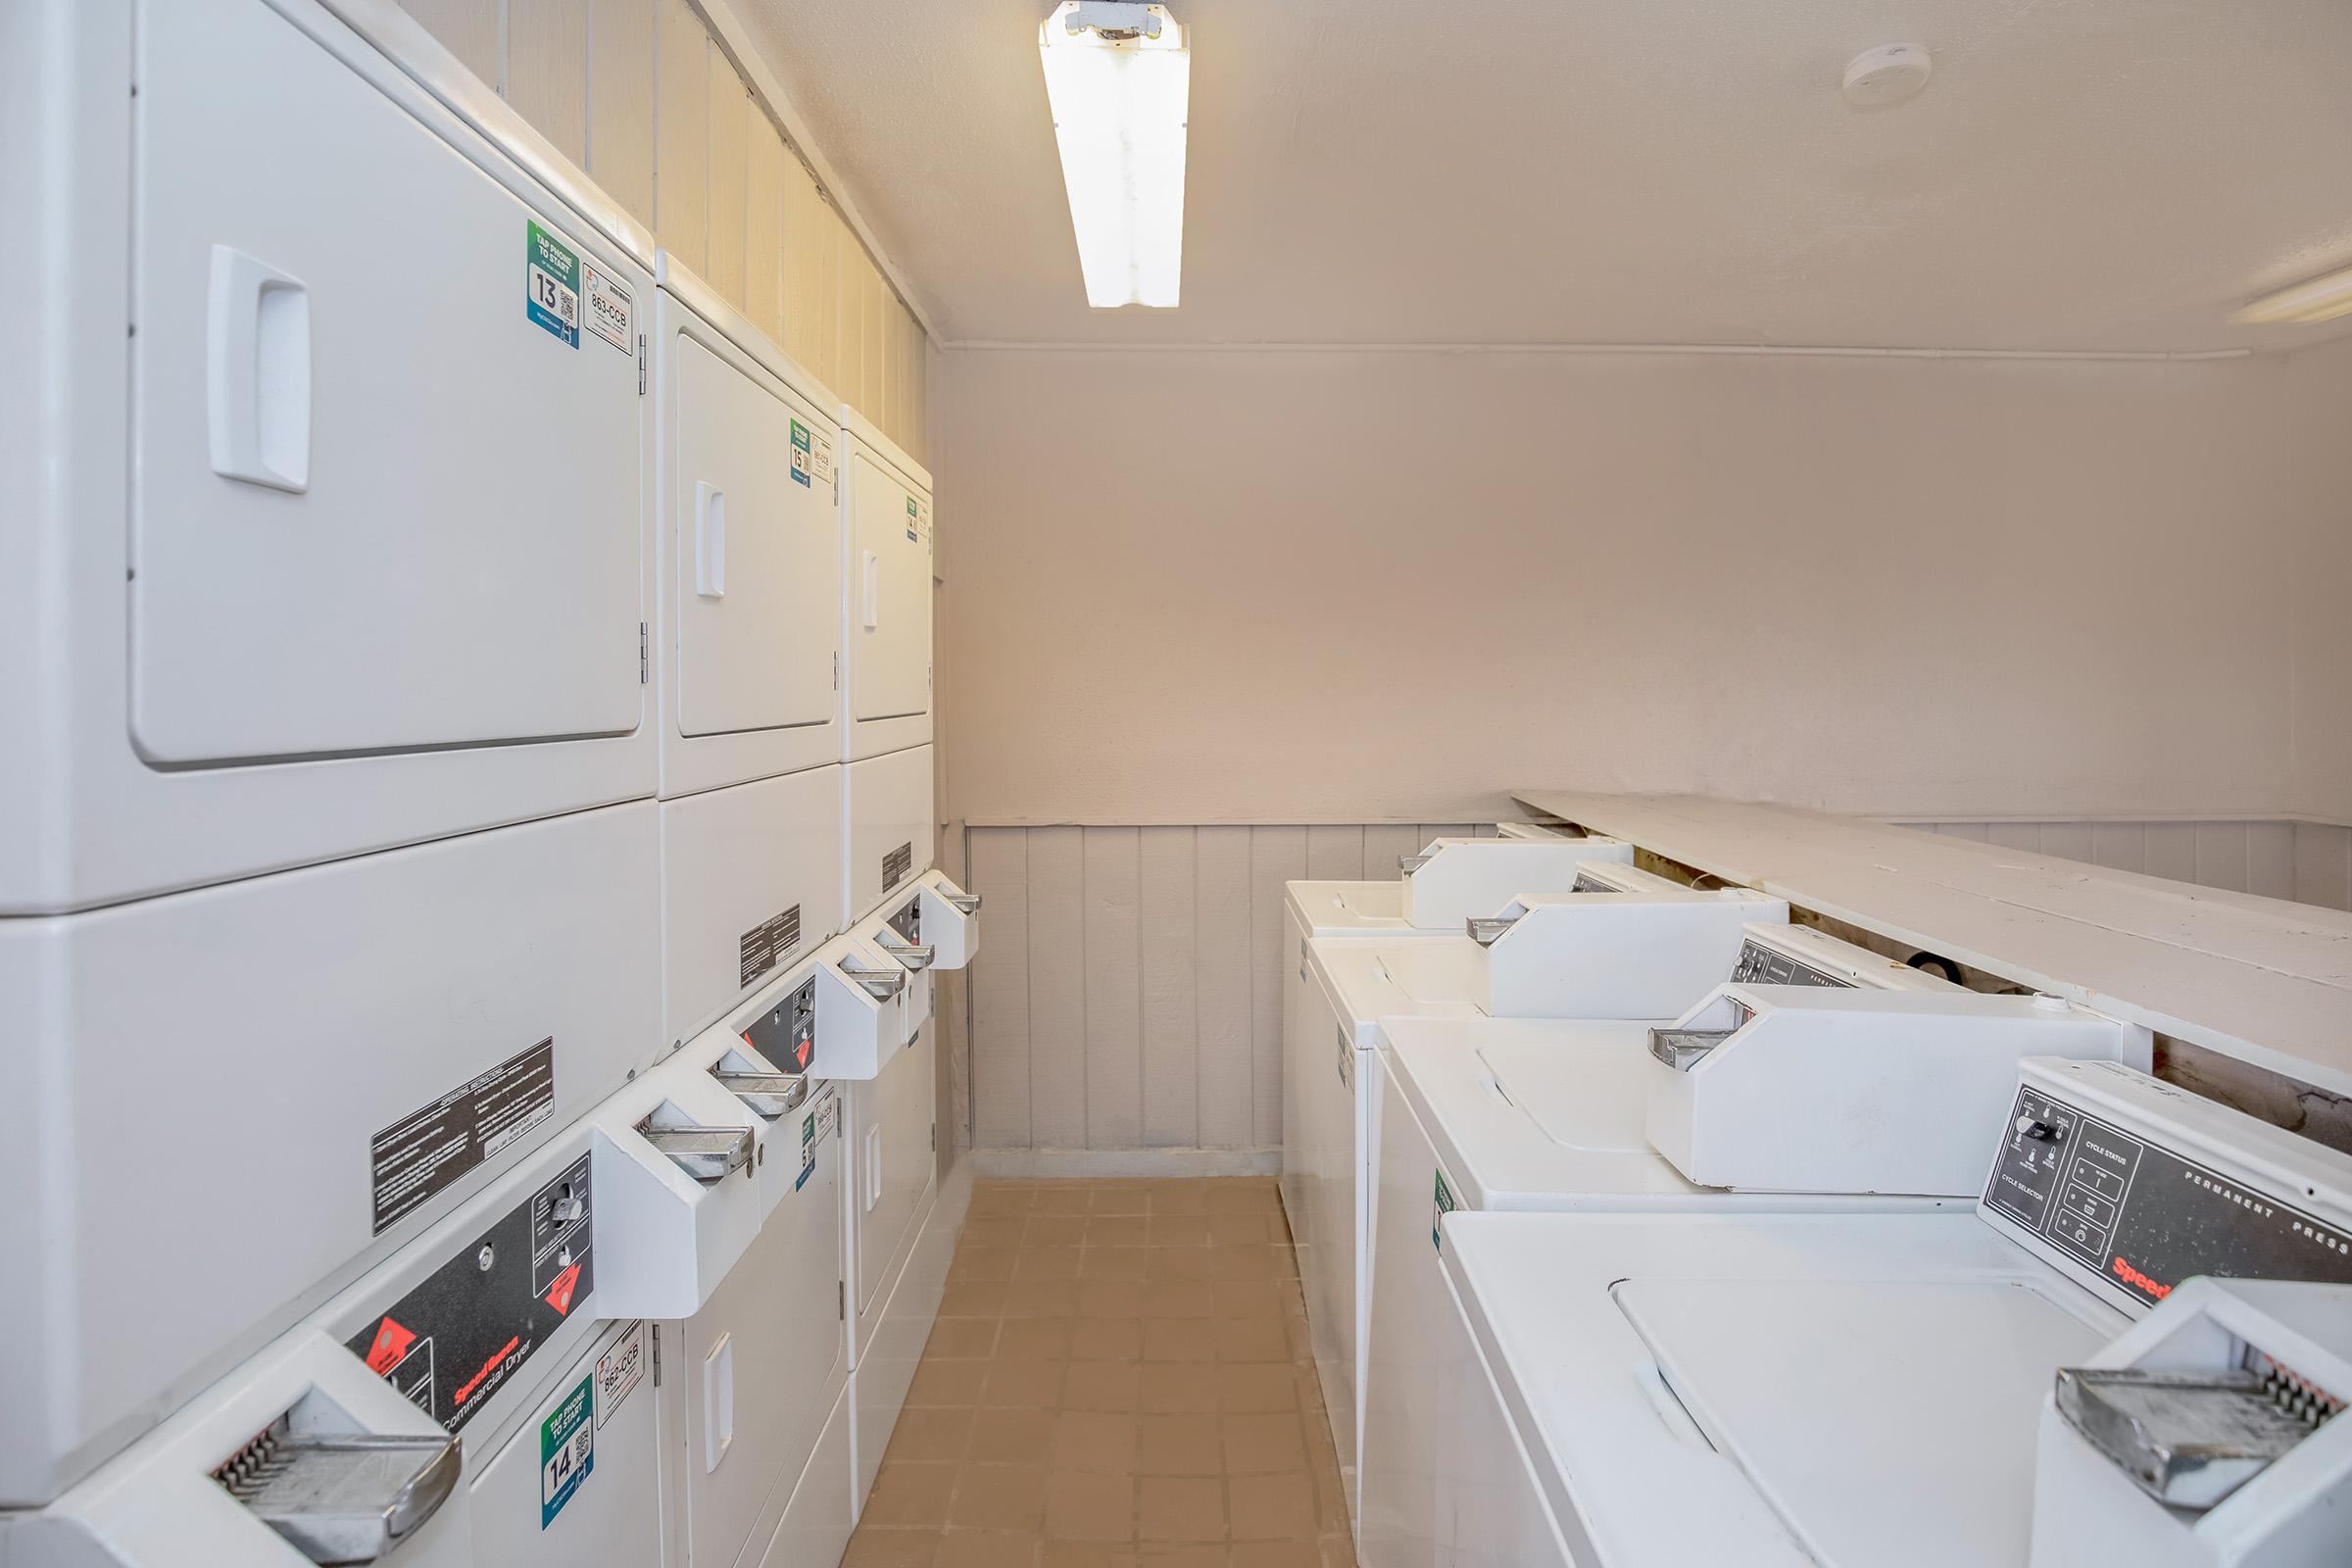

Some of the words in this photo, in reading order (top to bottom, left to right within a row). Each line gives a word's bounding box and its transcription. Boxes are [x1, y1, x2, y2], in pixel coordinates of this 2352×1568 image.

[536, 233, 550, 248] TAP
[550, 244, 572, 268] PHONE
[539, 246, 549, 260] TO
[550, 253, 570, 274] START
[536, 273, 557, 309] 13
[591, 293, 626, 327] 863-CCB
[794, 449, 803, 467] 15
[2085, 1140, 2105, 1155] CYCLE
[2104, 1150, 2127, 1166] STATUS
[2002, 1173, 2018, 1187] CYCLE
[2018, 1182, 2043, 1201] SELECTOR
[2184, 1170, 2274, 1219] PERMANENT
[2291, 1221, 2349, 1255] PRESS
[2112, 1256, 2172, 1300] Speed
[442, 1368, 504, 1431] Commercial
[505, 1339, 531, 1371] Dryer
[454, 1362, 488, 1406] Speed
[605, 1344, 639, 1393] 862-CCB
[550, 1412, 563, 1431] TAP
[564, 1388, 586, 1419] PHONE
[552, 1424, 563, 1439] TO
[563, 1402, 584, 1430] START
[550, 1445, 572, 1490] 14
